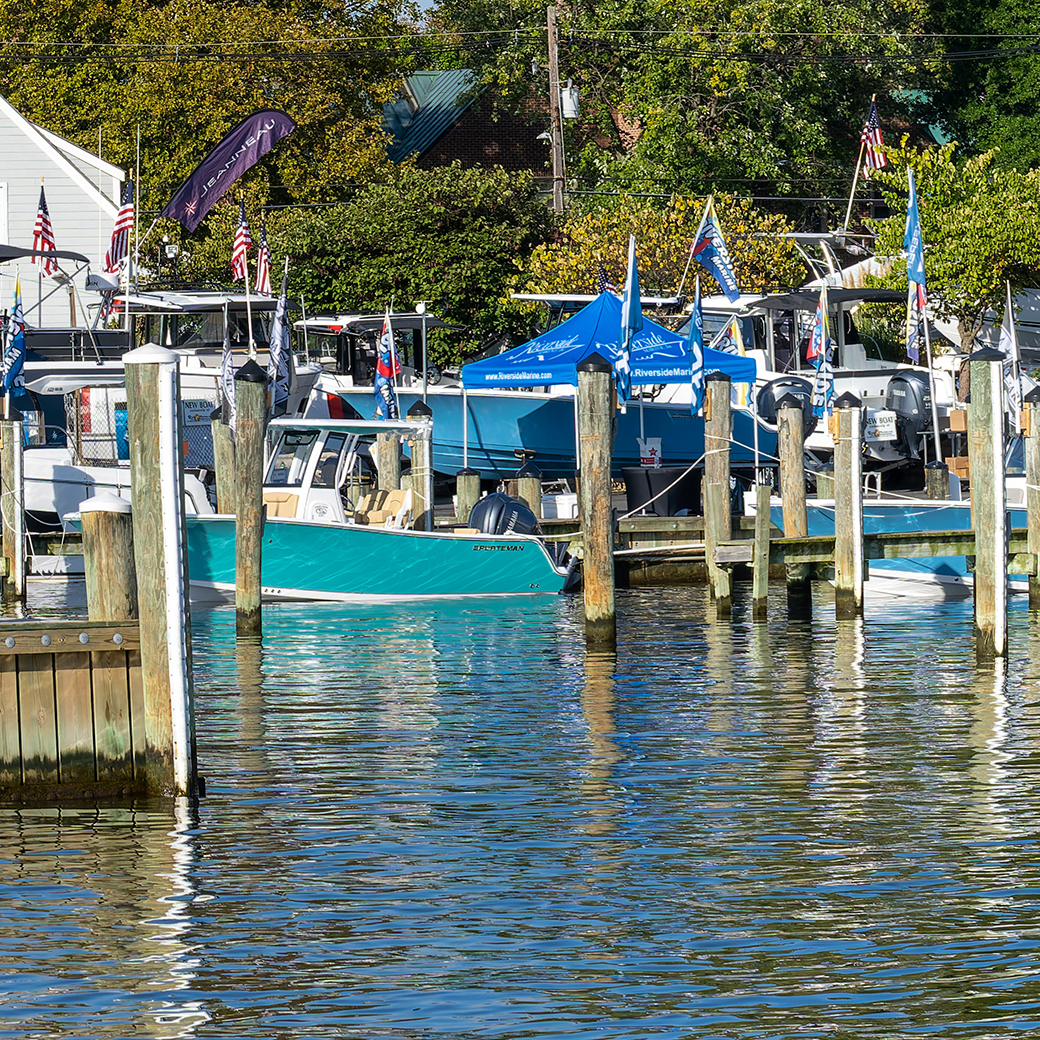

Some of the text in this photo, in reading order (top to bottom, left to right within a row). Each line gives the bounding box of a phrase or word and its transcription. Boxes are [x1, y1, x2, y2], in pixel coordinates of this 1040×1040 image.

[200, 119, 275, 198] JEANNEAU
[711, 256, 736, 291] MARINE
[485, 371, 553, 381] www.RiversideMarine.com
[185, 401, 198, 409] NEW
